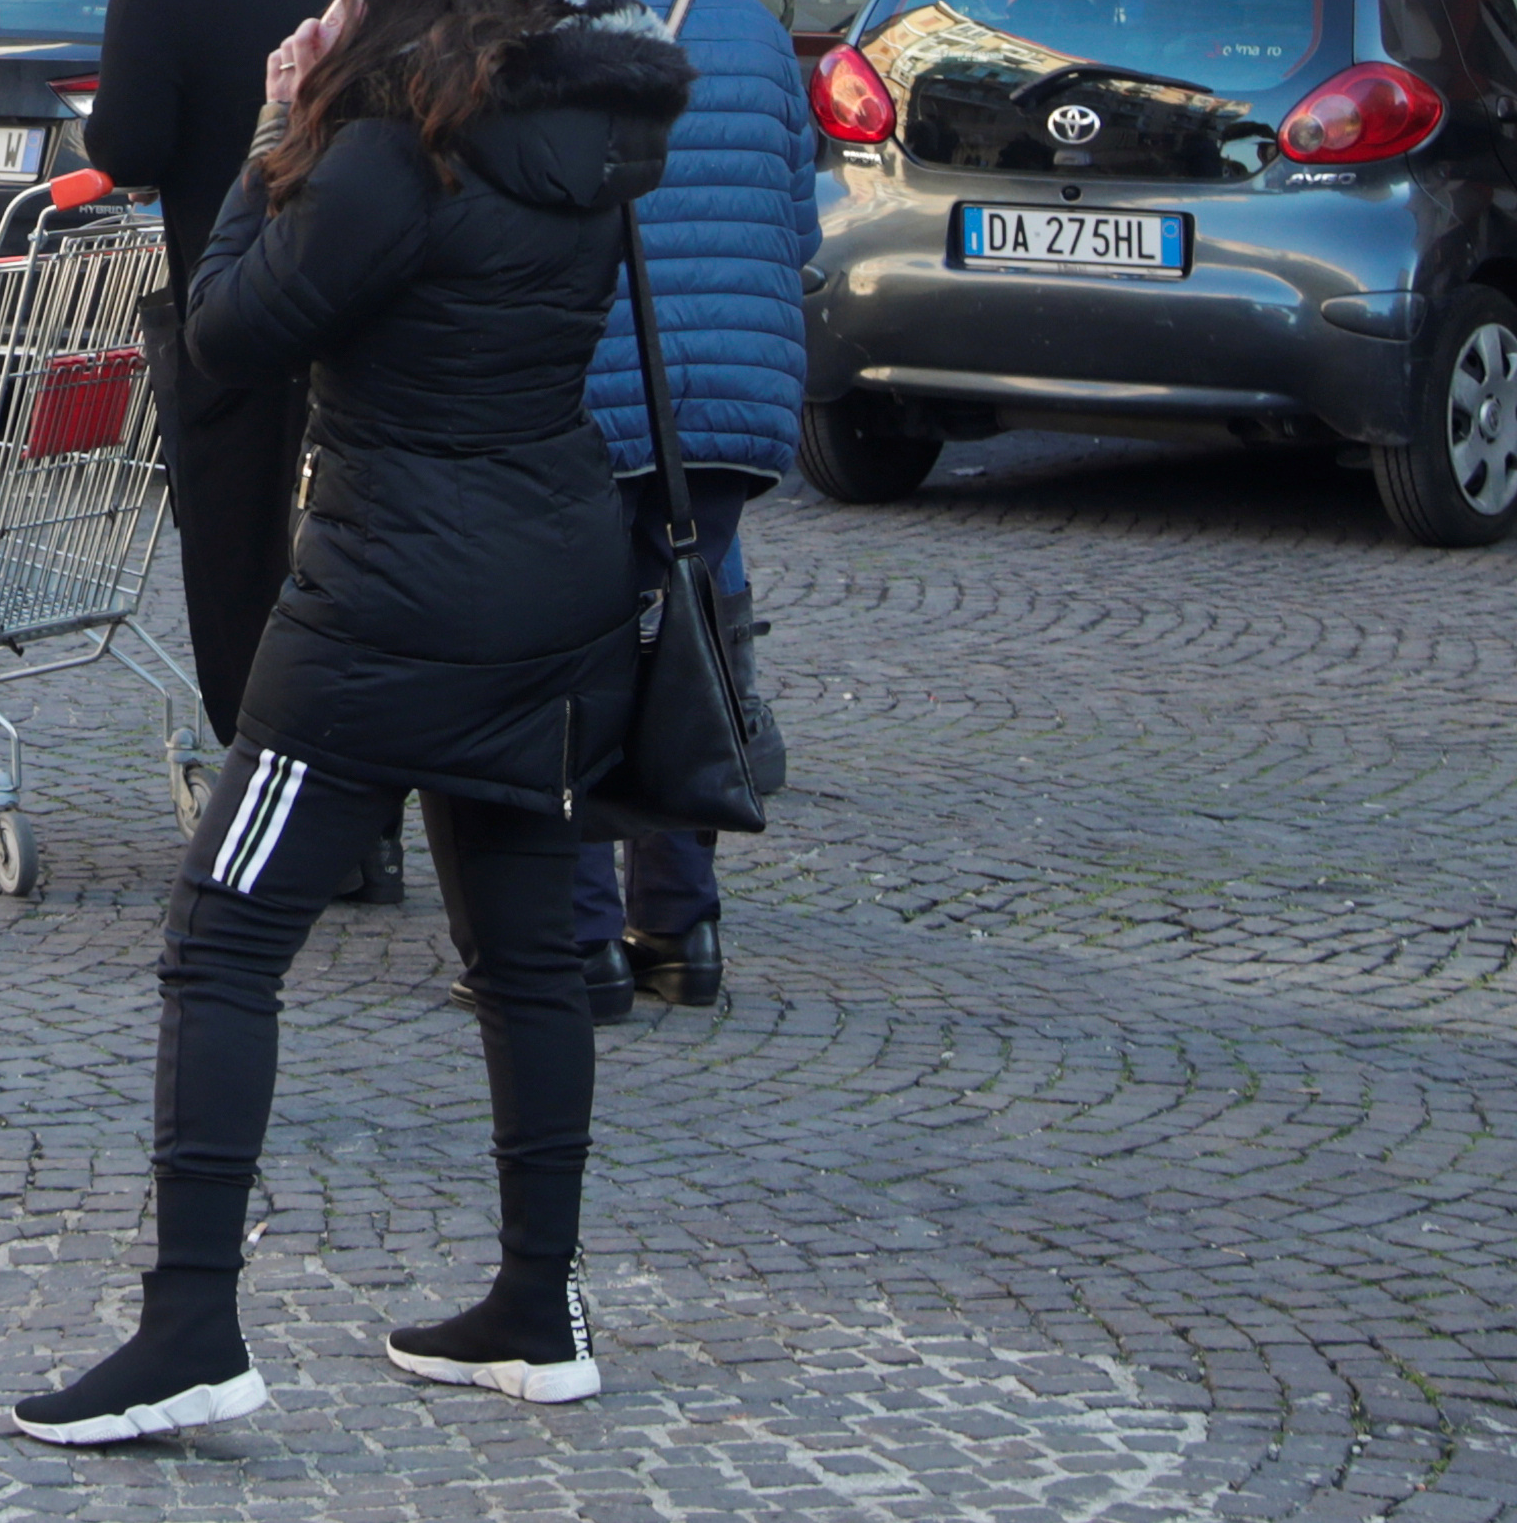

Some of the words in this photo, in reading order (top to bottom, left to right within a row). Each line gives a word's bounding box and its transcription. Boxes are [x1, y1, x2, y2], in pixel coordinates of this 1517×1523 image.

[1285, 172, 1357, 186] AYGO
[78, 204, 124, 215] HYBRID
[988, 213, 1030, 254] DA
[1045, 215, 1156, 261] 275HL
